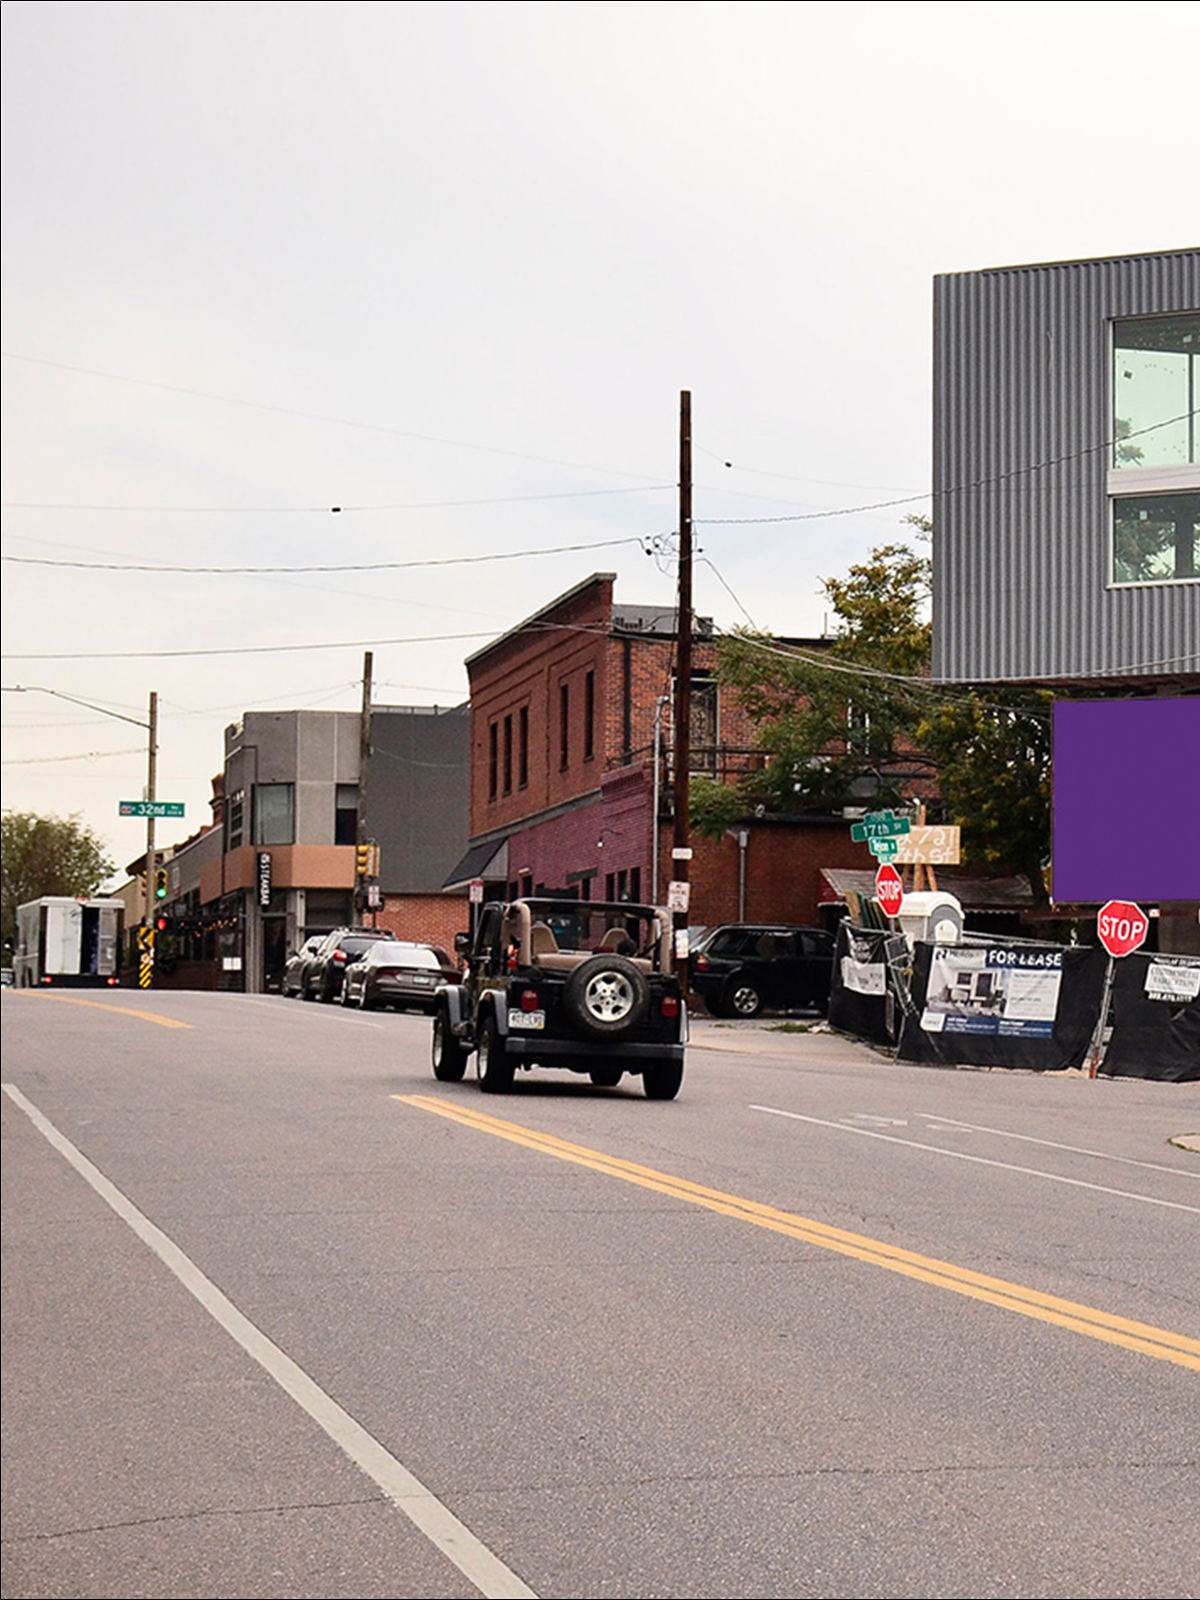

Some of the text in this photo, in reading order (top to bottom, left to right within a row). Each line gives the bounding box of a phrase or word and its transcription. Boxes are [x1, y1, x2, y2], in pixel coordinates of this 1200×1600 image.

[137, 804, 166, 815] 32nd
[863, 824, 890, 838] 17th
[878, 881, 902, 900] STOP
[1101, 915, 1144, 941] STOP
[988, 950, 1017, 965] FOR
[1019, 953, 1062, 967] LEASE
